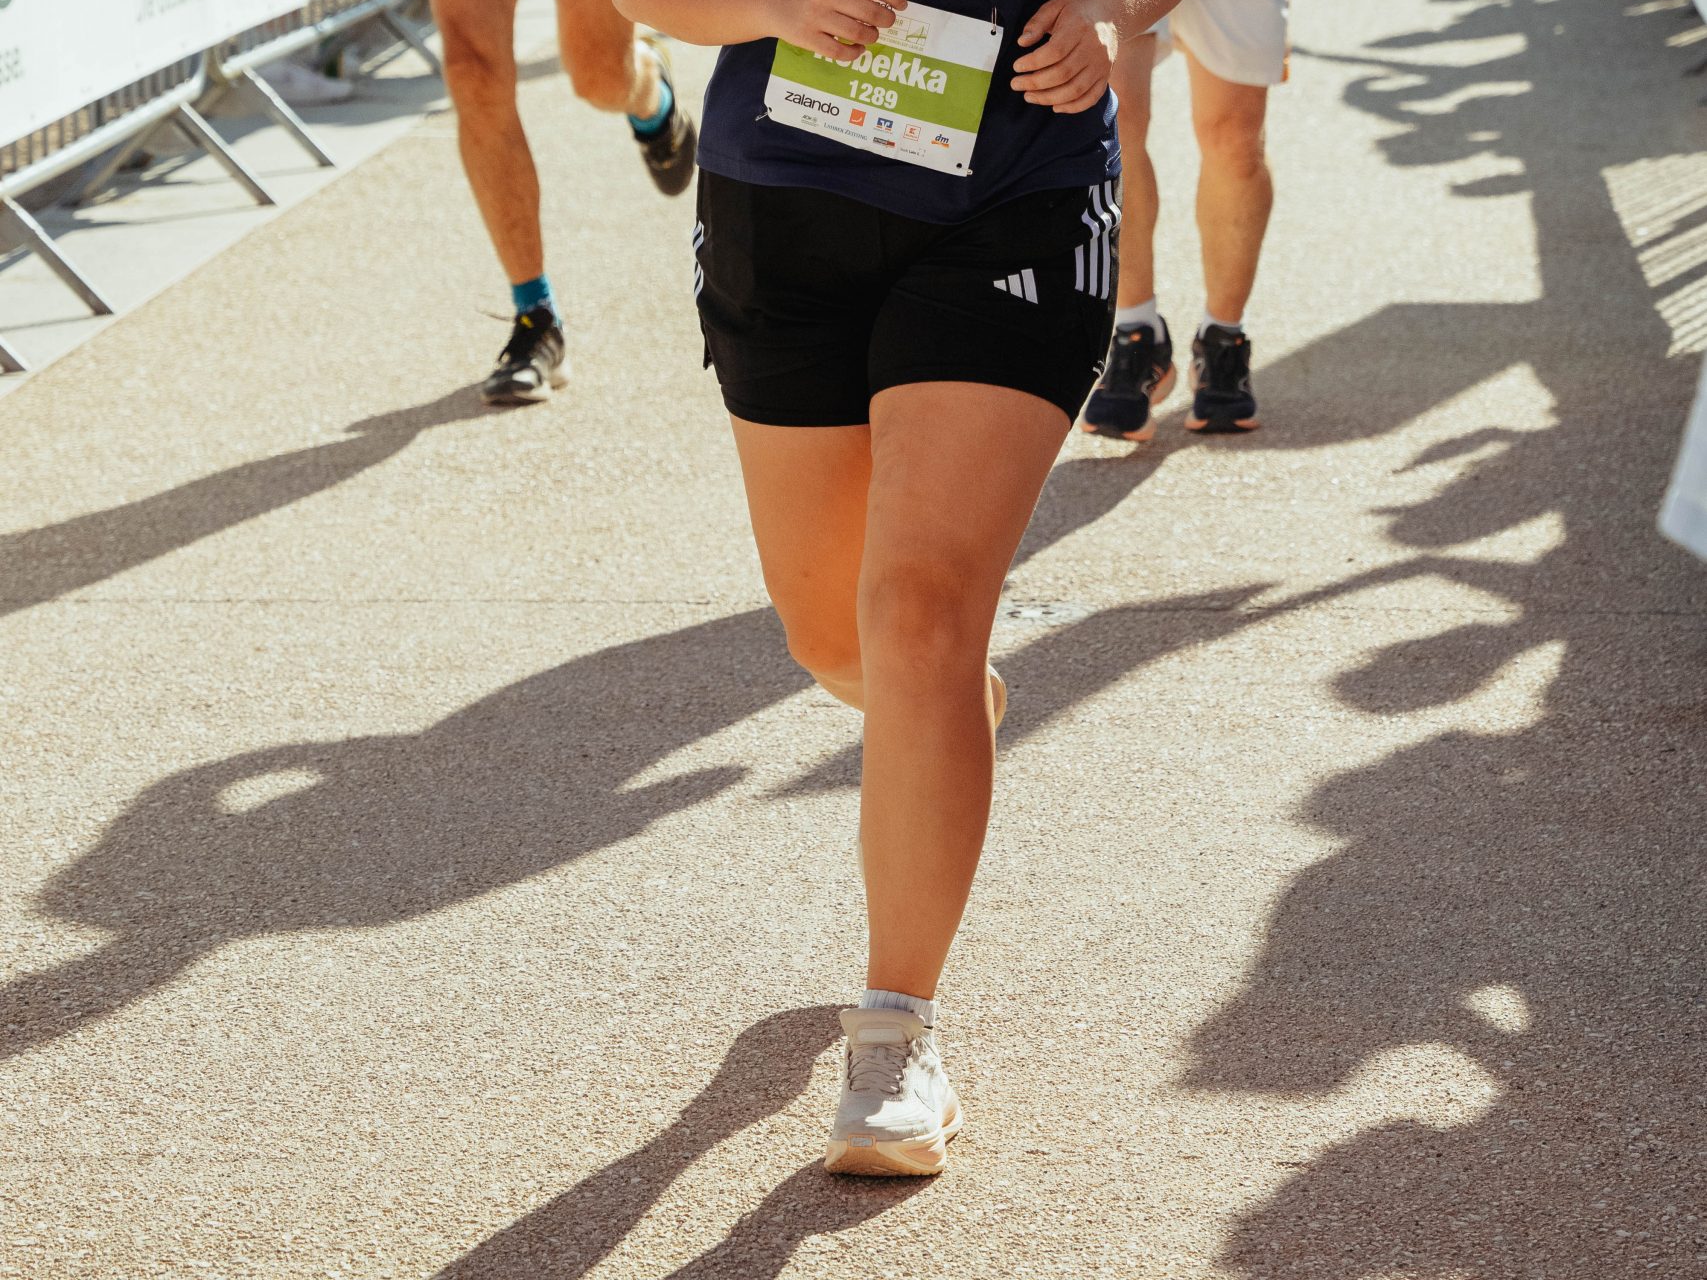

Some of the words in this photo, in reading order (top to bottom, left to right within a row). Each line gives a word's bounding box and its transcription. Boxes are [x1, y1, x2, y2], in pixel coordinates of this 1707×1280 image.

[784, 91, 840, 116] zalando
[849, 80, 898, 109] 1289
[935, 133, 949, 143] dm
